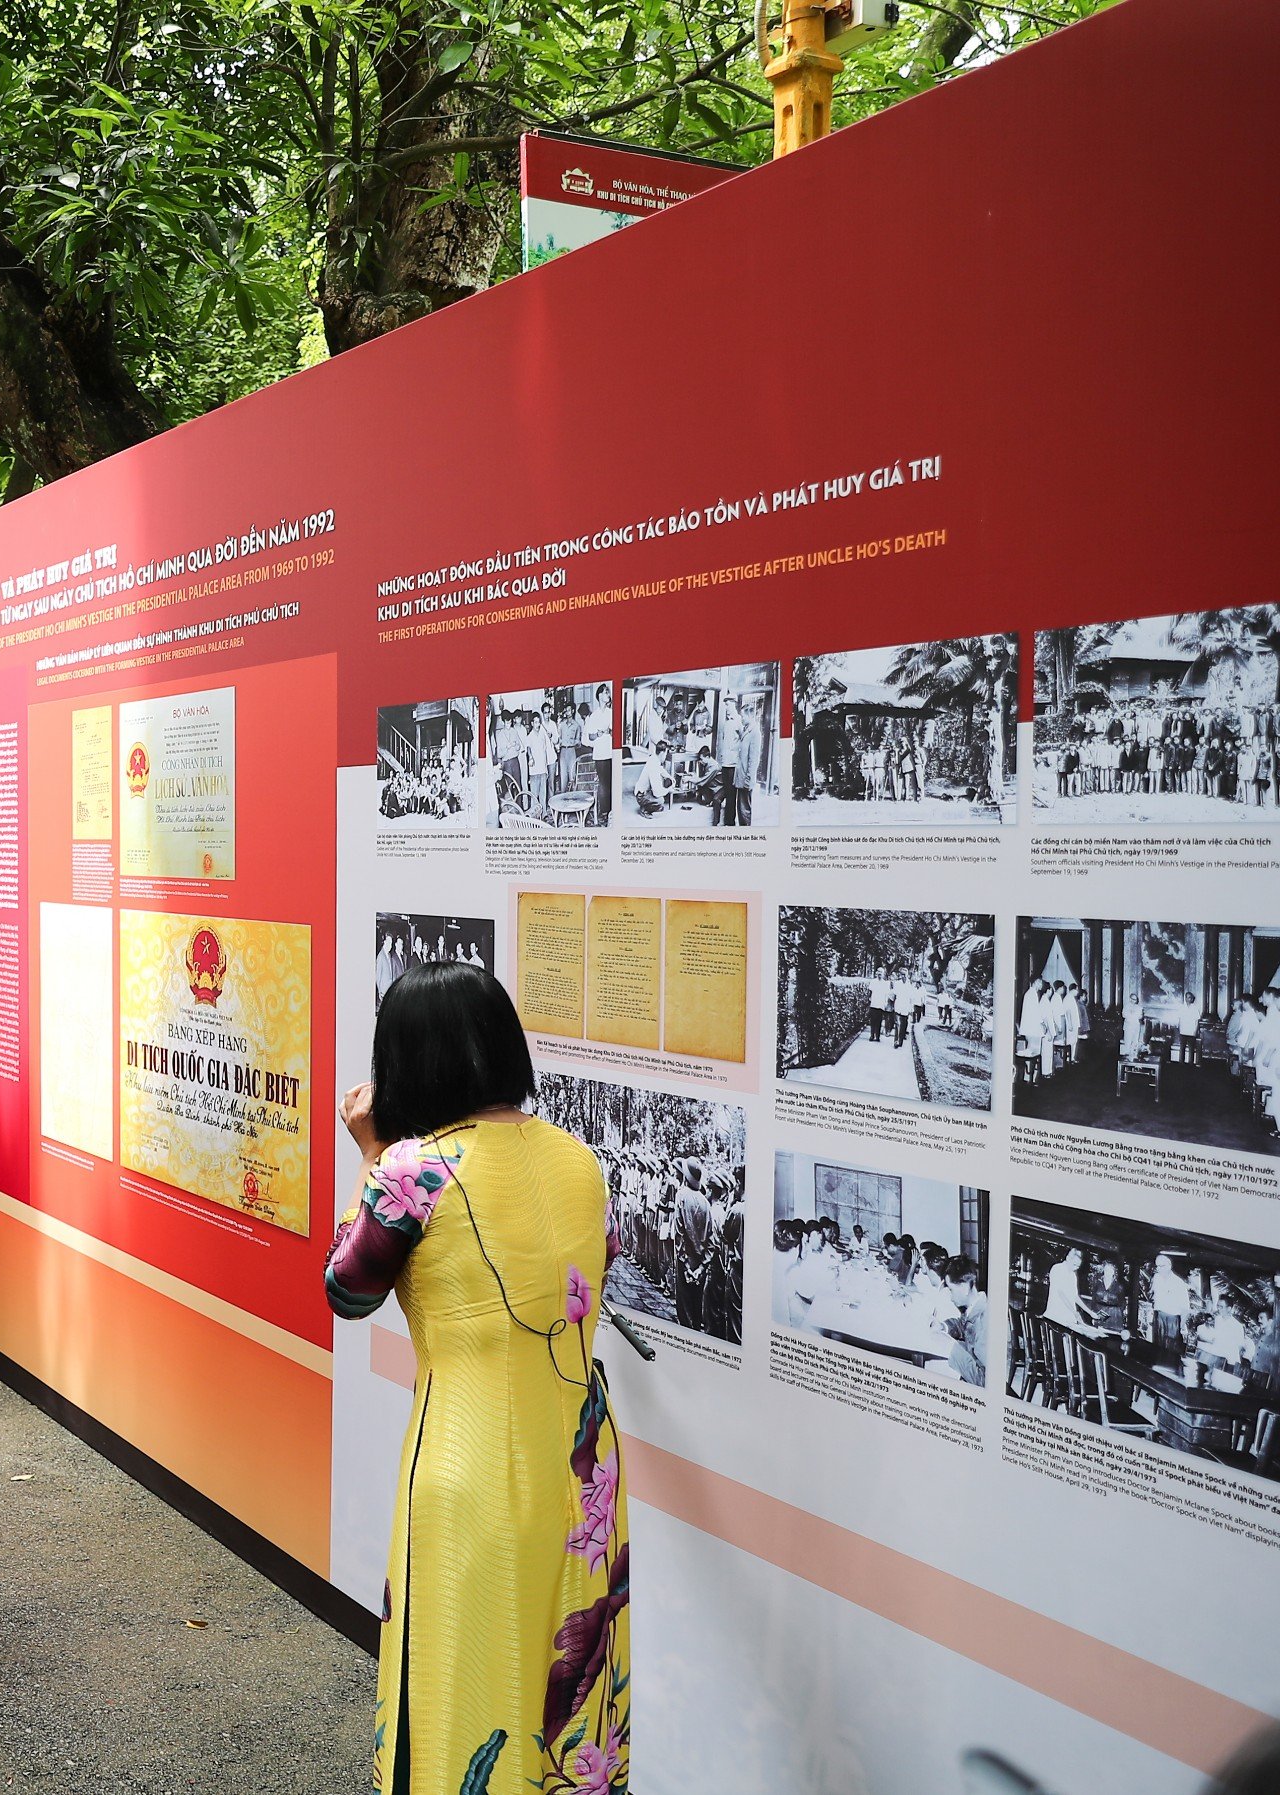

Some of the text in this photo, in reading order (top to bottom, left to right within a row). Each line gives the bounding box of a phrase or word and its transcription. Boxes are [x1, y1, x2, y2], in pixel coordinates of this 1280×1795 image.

[597, 191, 608, 199] KHU
[610, 193, 616, 201] DI
[624, 182, 637, 192] VĂN
[378, 456, 940, 597] NHỮNG HOẠT ĐỘNG ĐẦU TIÊN TRONG CÔNG TÁC BẢO TỒN VÀ PHÁT HUY GIÁ TRỊ
[1, 576, 14, 599] VÀ
[16, 568, 44, 595] PHÁT
[47, 561, 69, 585] HUY
[72, 550, 92, 576] GIÁ
[95, 544, 116, 569] TRỊ
[34, 596, 49, 616] SAU
[51, 587, 74, 611] NGÀY
[75, 577, 94, 603] CHỦ
[96, 575, 116, 599] TỊCH
[119, 564, 134, 591] HỒ
[137, 560, 154, 585] CHÍ
[156, 555, 184, 580] MINH
[188, 547, 212, 572] QUA
[215, 536, 237, 563] ĐỜI
[241, 525, 265, 556] ĐẾN
[270, 519, 299, 548] NĂM
[303, 509, 334, 538] 1992
[378, 530, 945, 643] THE FIRST OPERATIONS FOR CONSERVING AND ENHANCING VALUE OF THE VESTIGE AFTER UNCLE HO'S DEATH
[5, 635, 15, 647] THE
[16, 626, 44, 644] PRESIDENT
[45, 624, 54, 636] HO
[54, 621, 64, 634] CHI
[88, 608, 113, 625] VESTIGE
[114, 606, 121, 619] IN
[122, 602, 135, 616] THE
[136, 588, 187, 615] PRESIDENTIAL
[189, 580, 218, 600] PALACE
[220, 574, 242, 592] AREA
[244, 566, 269, 585] FROM
[272, 560, 293, 578] 1969
[295, 556, 308, 572] TO
[311, 549, 334, 568] 1992
[378, 568, 565, 621] KHU DI TÍCH SAU KHI BÁC QUA ĐỜI
[173, 708, 181, 719] BỘ
[200, 757, 206, 768] DI
[196, 1029, 215, 1046] XẾP
[128, 1041, 299, 1108] DI TÍCH QUỐC GIA ĐẶC BIỆT
[1002, 1454, 1018, 1466] Uncle
[1045, 1469, 1064, 1482] House,
[1066, 1476, 1080, 1487] April
[1092, 1485, 1106, 1496] 1973
